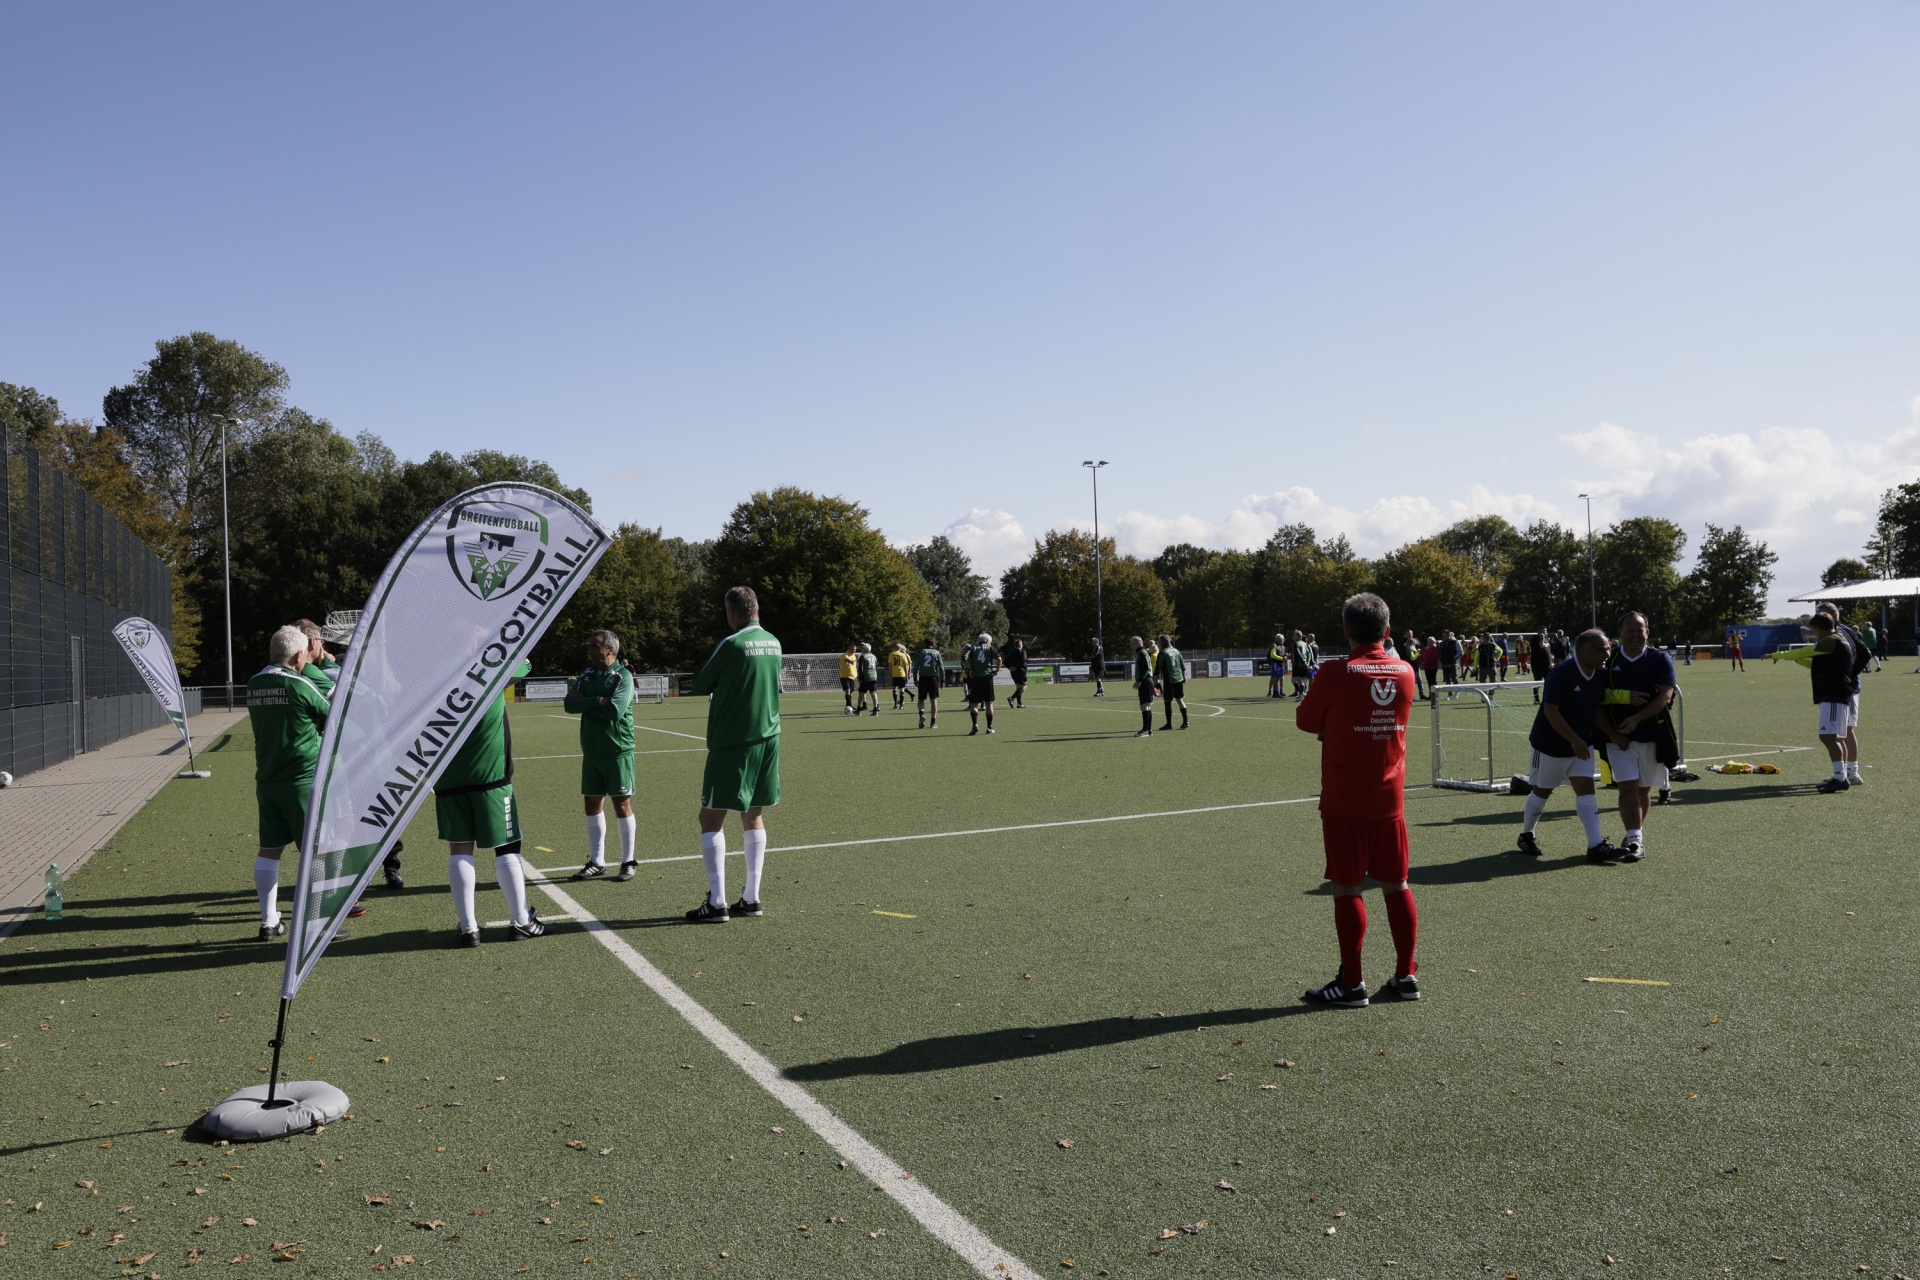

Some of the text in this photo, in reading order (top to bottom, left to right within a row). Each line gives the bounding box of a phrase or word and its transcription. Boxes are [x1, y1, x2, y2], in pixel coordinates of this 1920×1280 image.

[977, 650, 985, 663] 4
[924, 655, 932, 667] 2
[1347, 664, 1380, 673] FORTUNA
[360, 536, 595, 829] WALKING FOOTBALL
[252, 688, 286, 696] HARSEWINKEL
[263, 697, 289, 705] FOOTBALL
[1370, 716, 1395, 724] Deutsche
[1372, 733, 1392, 741] Bottrop
